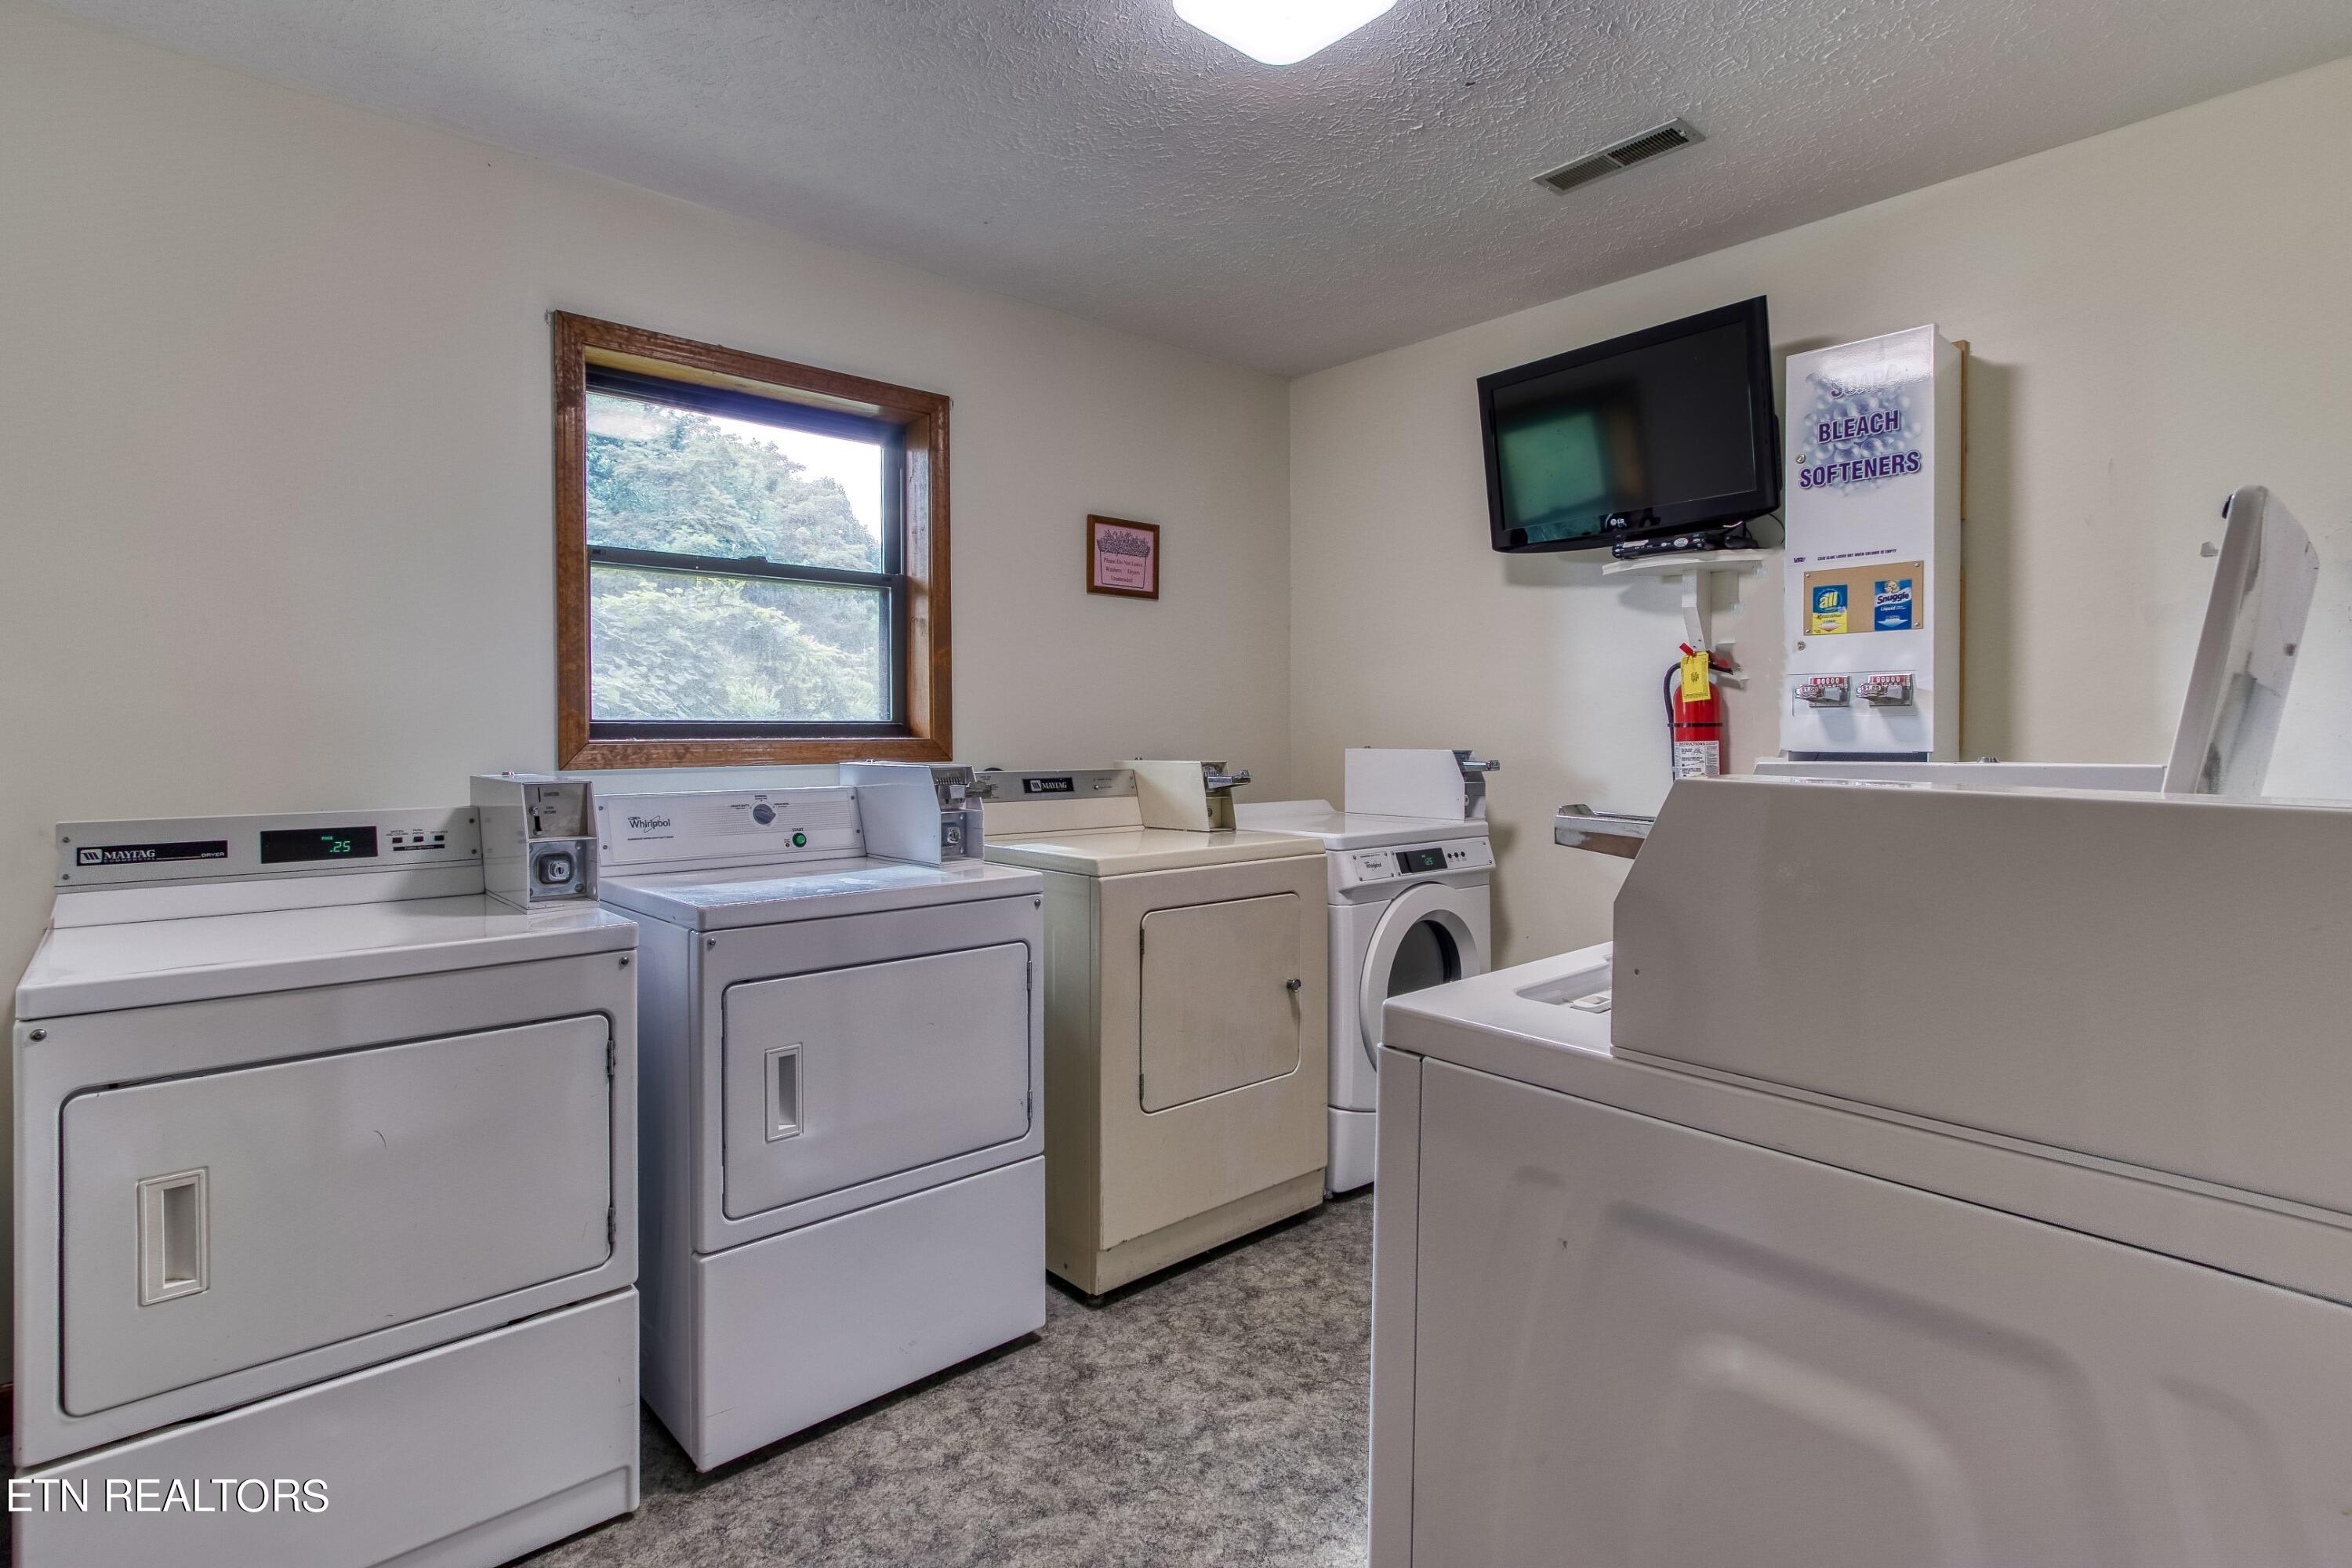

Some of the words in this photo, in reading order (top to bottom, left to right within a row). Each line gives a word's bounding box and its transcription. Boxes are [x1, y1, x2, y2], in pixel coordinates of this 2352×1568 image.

[1817, 408, 1900, 444] BLEACH
[1798, 450, 1922, 489] SOFTENERS
[1819, 591, 1838, 608] all
[1877, 591, 1910, 604] Snuggle
[628, 816, 671, 831] Whirlpool
[103, 849, 156, 859] MAYTAG
